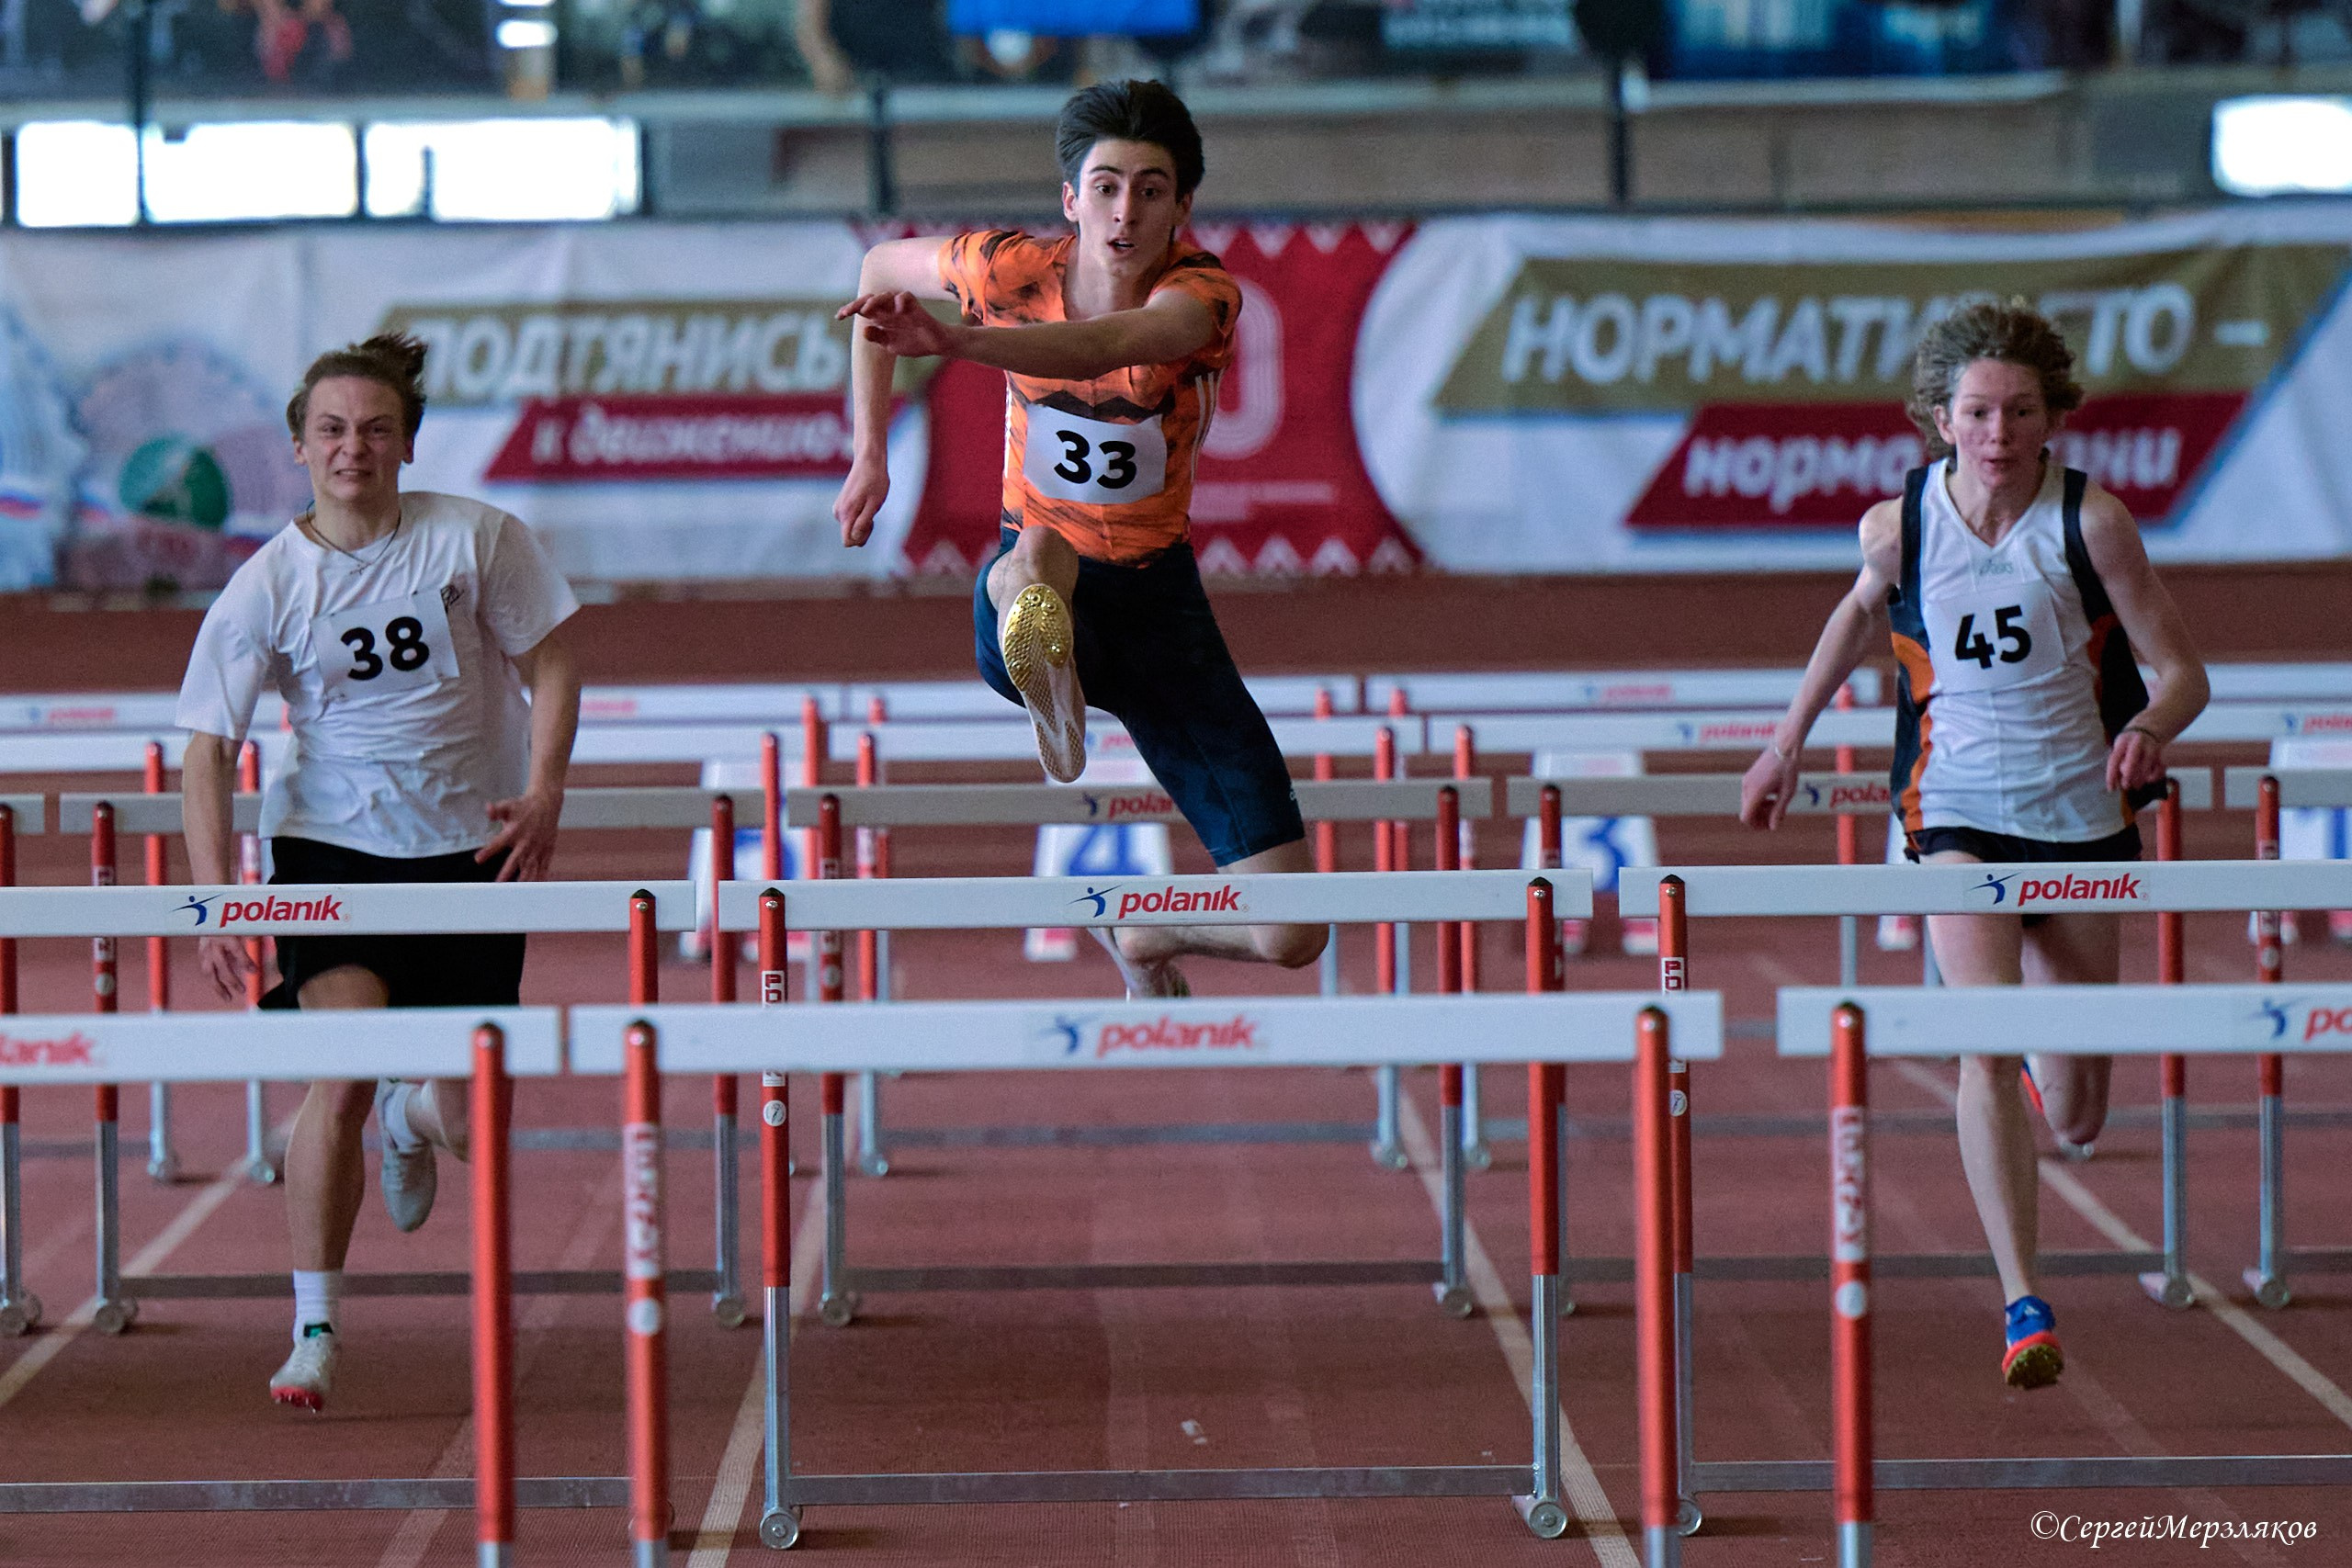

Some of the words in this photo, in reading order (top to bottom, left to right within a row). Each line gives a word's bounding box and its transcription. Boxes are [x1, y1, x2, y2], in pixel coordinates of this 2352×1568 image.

[1501, 292, 2003, 387] НОРМАТИ
[1054, 429, 1137, 490] 33
[340, 615, 430, 681] 38
[1954, 604, 2032, 670] 45
[220, 894, 343, 929] polanik
[1117, 885, 1242, 919] polanik
[2018, 873, 2141, 908] polanik
[1095, 1015, 1259, 1058] polanik
